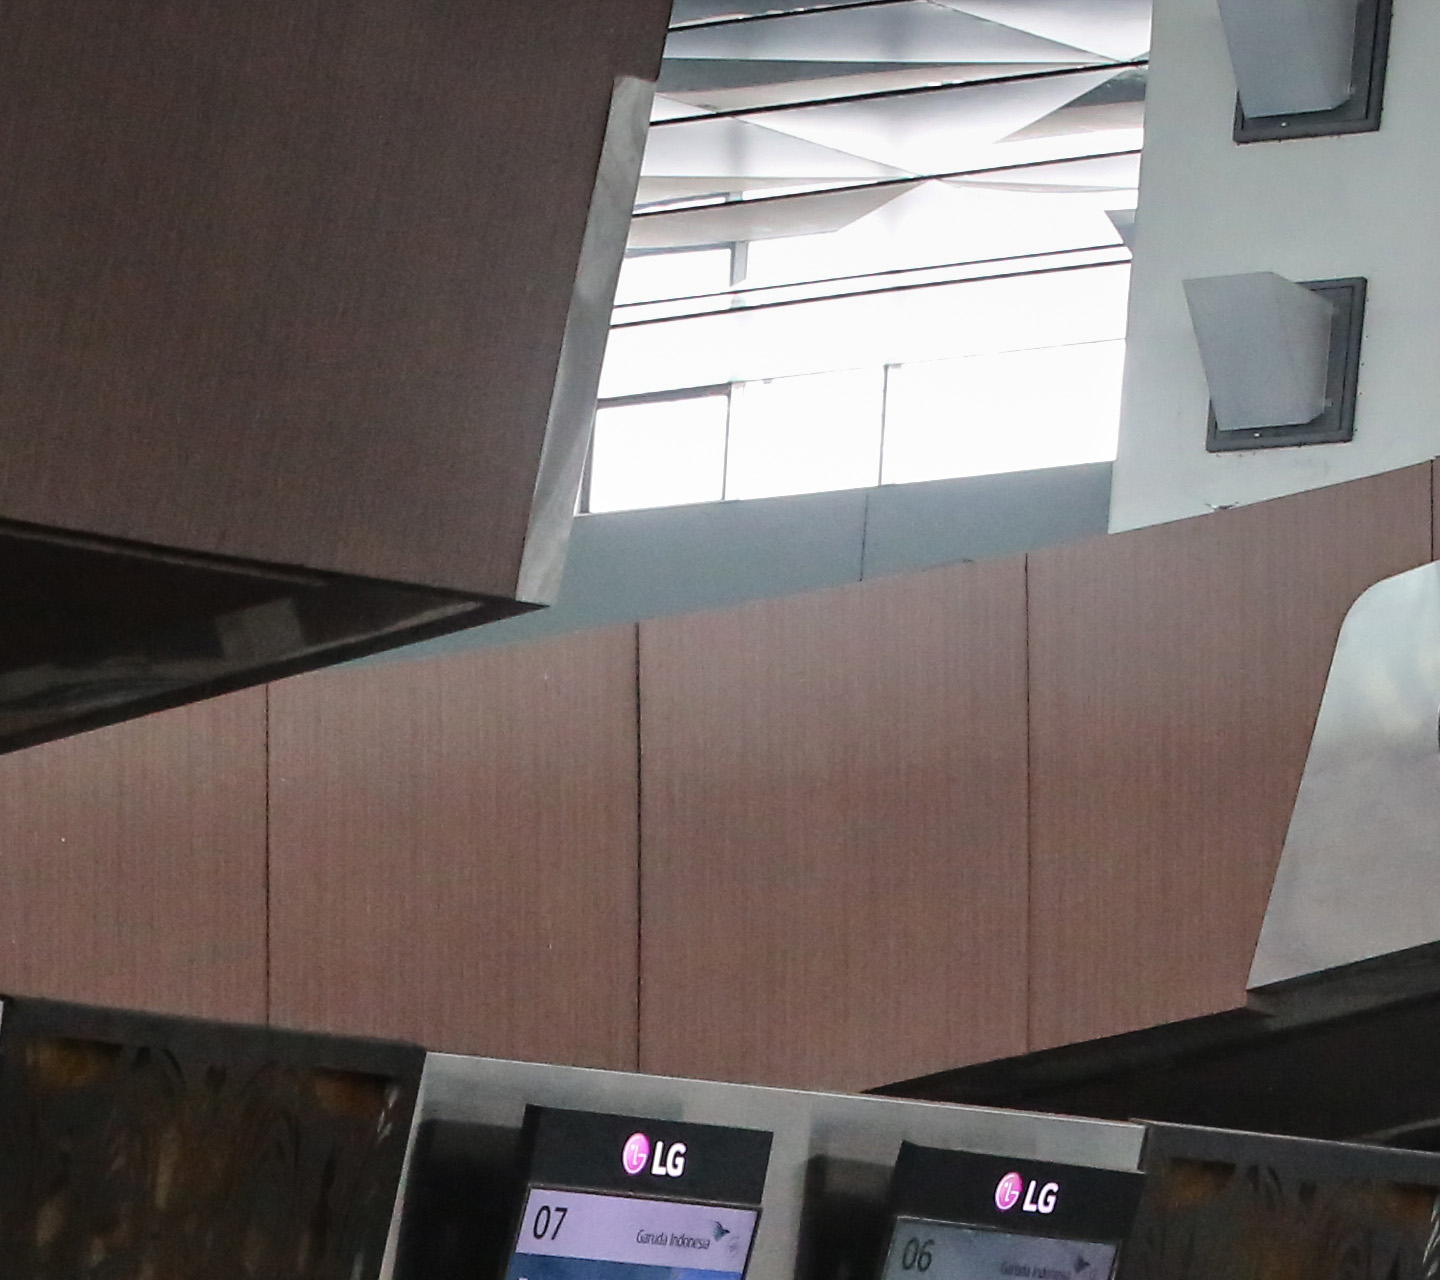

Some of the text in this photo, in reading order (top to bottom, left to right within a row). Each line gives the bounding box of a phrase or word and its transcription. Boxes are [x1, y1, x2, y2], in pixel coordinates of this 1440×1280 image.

[652, 1139, 686, 1177] LG
[1023, 1180, 1058, 1215] LG
[533, 1205, 568, 1240] 07
[637, 1229, 710, 1249] Garuda Indonesia
[902, 1237, 935, 1272] 06
